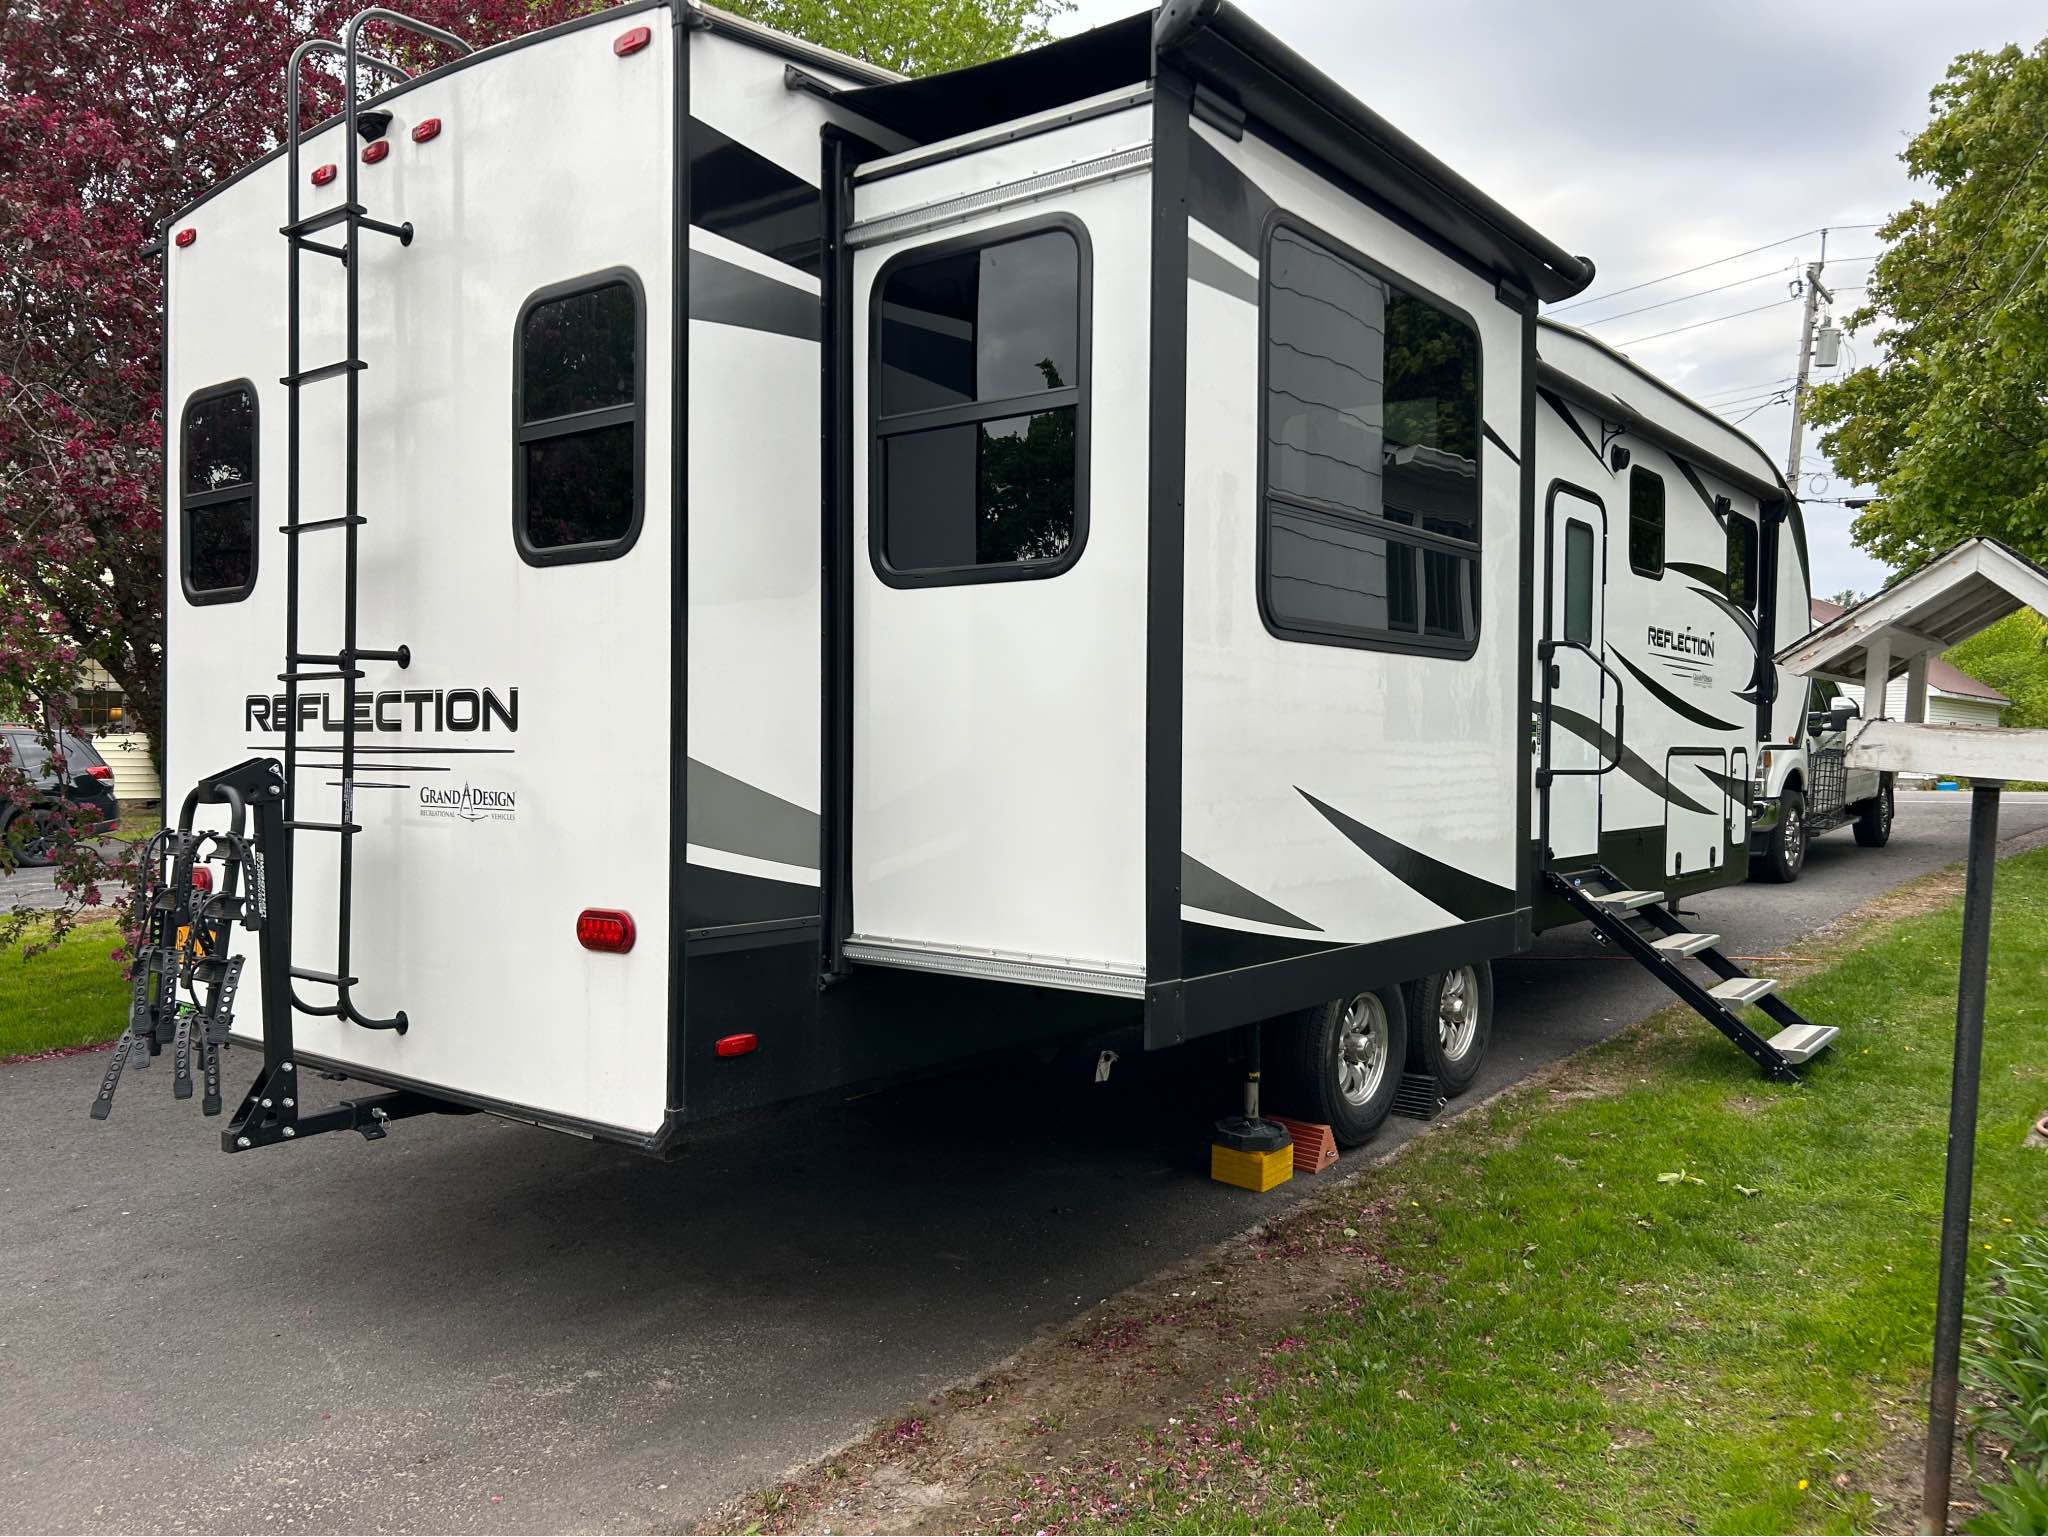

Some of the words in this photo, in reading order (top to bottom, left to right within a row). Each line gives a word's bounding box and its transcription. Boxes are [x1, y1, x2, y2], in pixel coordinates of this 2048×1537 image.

[1648, 626, 1715, 658] REFLECTION
[245, 686, 519, 733] REFLECTION
[420, 786, 461, 805] GRAND
[473, 788, 516, 807] DESIGN
